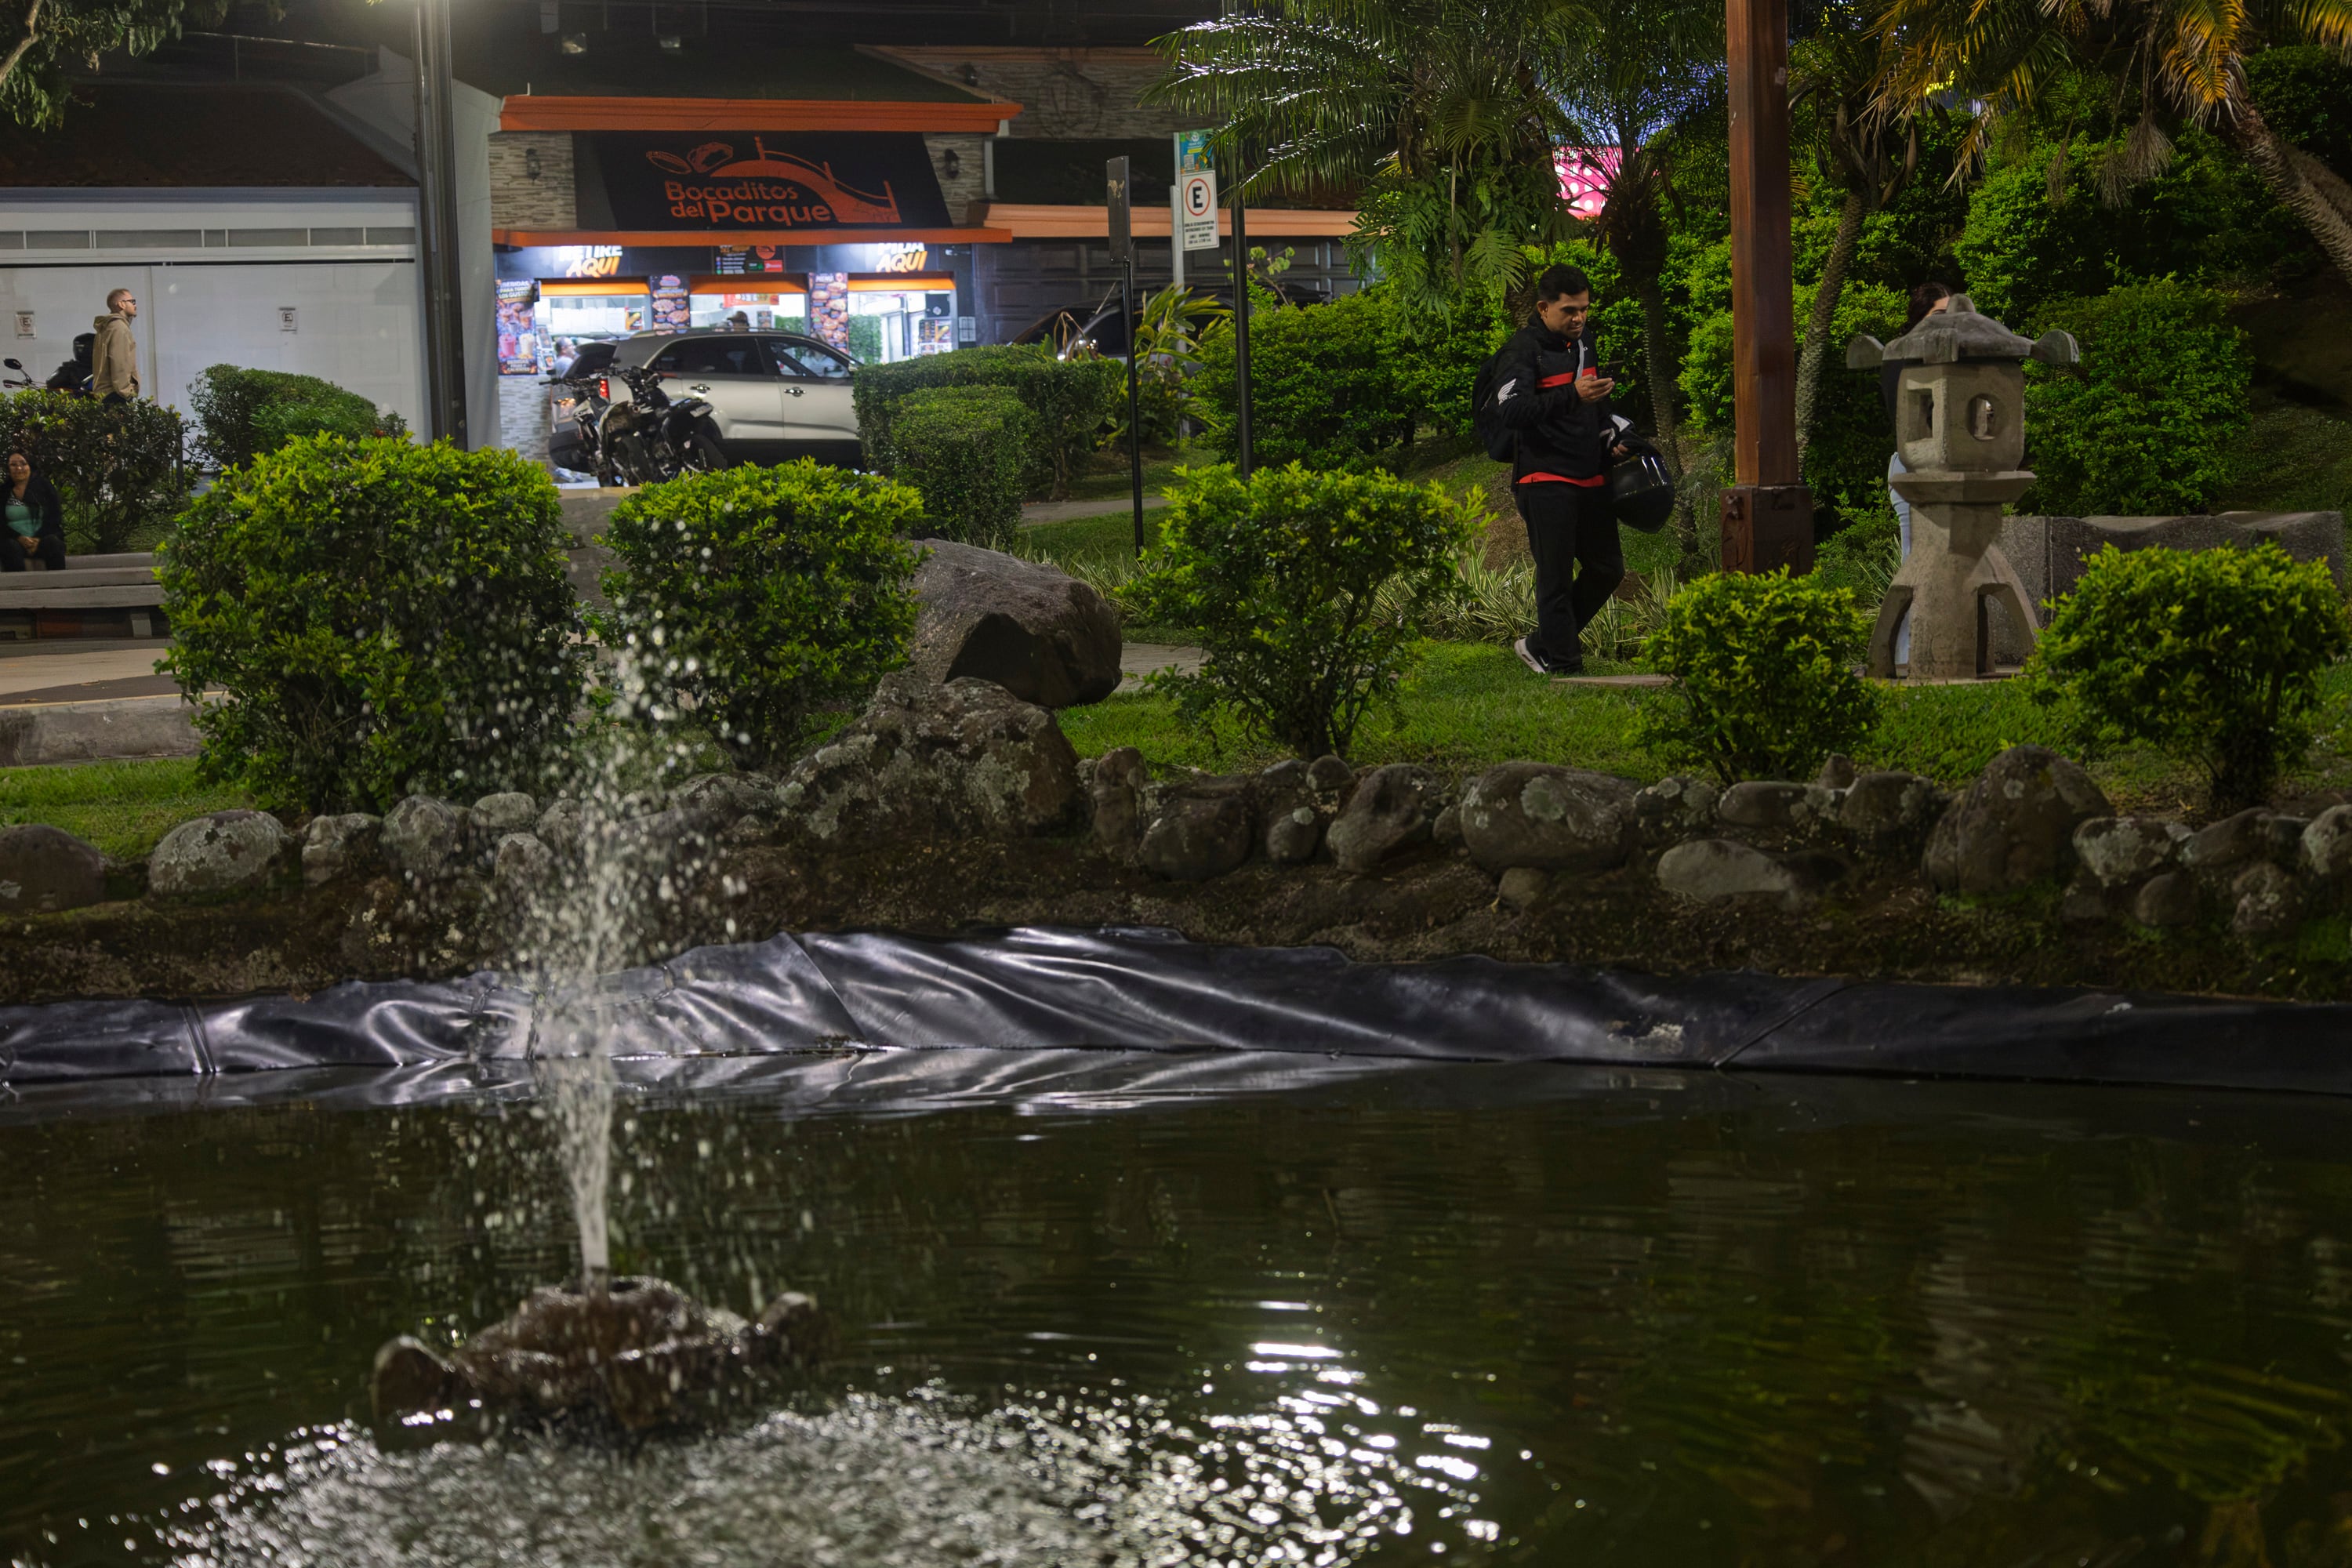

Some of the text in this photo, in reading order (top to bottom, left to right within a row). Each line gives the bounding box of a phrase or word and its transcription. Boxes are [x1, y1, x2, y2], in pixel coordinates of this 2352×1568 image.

[665, 180, 798, 201] Bocaditos
[1192, 186, 1203, 209] E
[671, 200, 831, 226] del Parque
[566, 256, 620, 278] AQUI
[876, 251, 927, 273] AQUI
